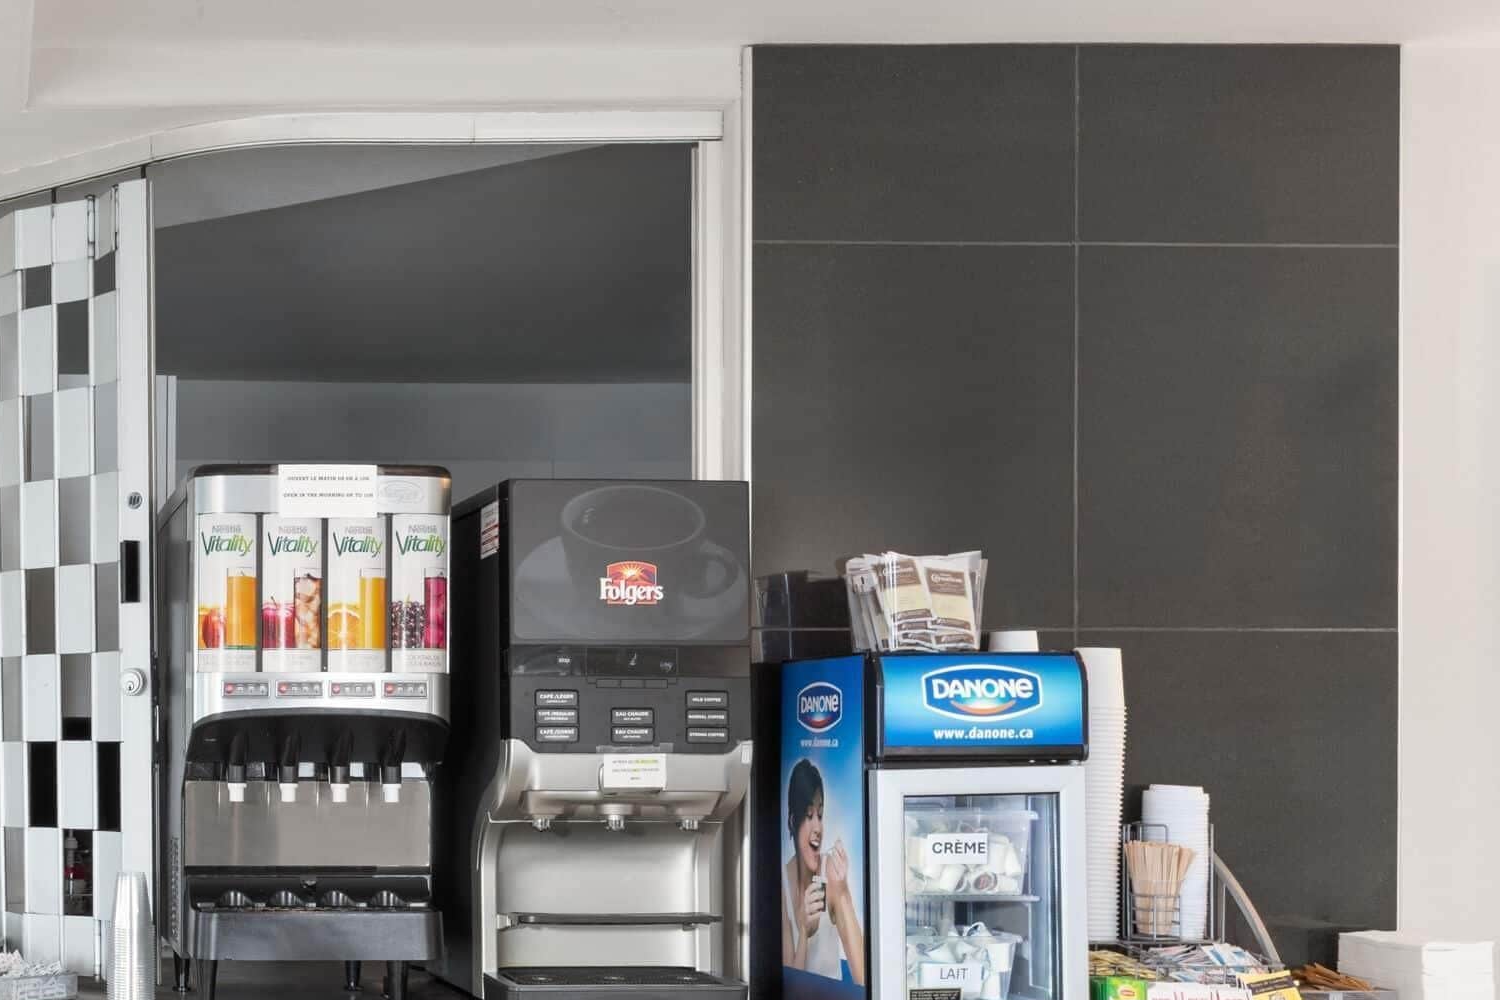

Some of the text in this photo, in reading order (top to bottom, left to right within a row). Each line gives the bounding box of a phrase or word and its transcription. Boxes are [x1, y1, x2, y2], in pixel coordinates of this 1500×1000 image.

[201, 531, 254, 557] Vitality
[267, 531, 318, 558] Vitality
[333, 531, 383, 558] Vitality
[395, 530, 446, 558] Vitality
[599, 577, 664, 605] Folgers
[933, 726, 1034, 739] www.danone.ca
[932, 839, 986, 854] CRÈME
[940, 968, 969, 980] LAIT
